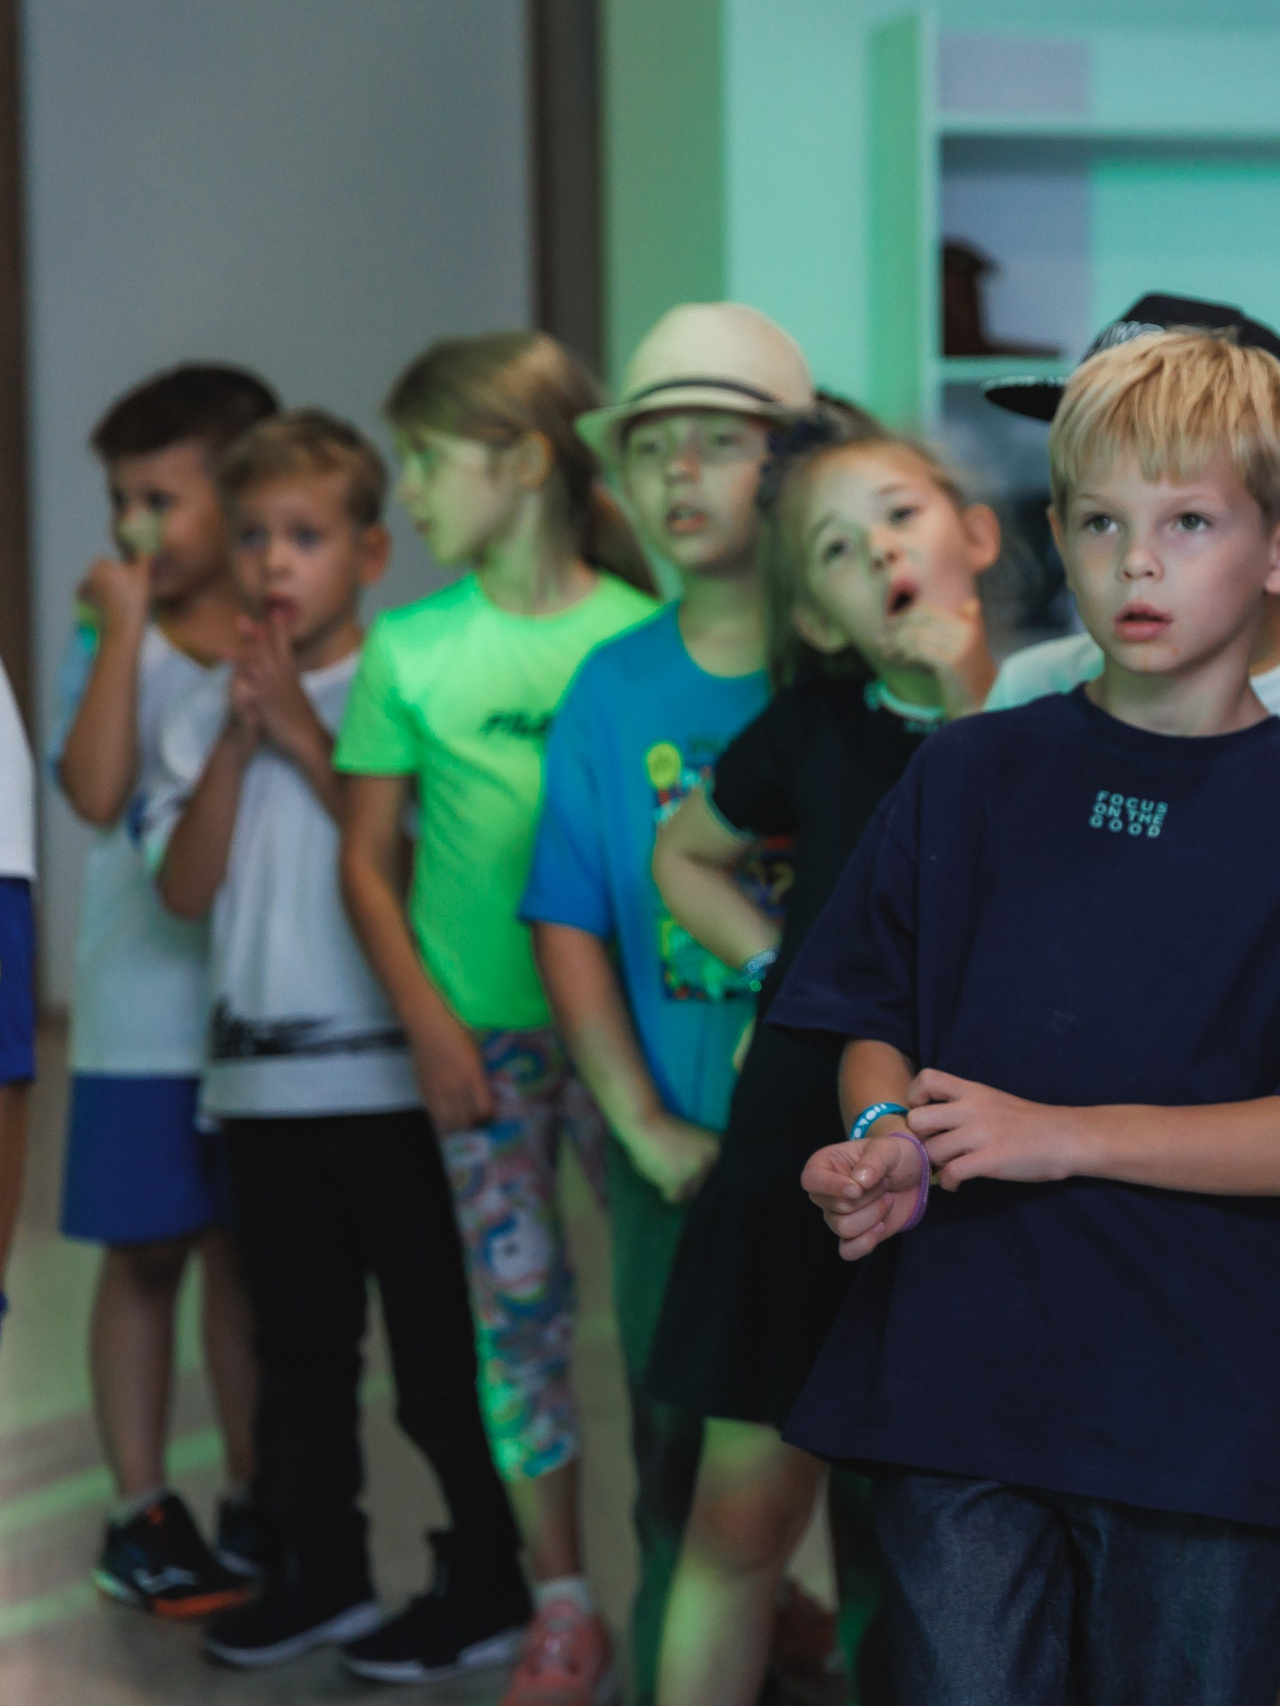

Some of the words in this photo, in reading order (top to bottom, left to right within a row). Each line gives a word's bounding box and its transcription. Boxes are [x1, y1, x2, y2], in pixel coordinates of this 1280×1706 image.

[1092, 802, 1121, 818] ON
[1128, 810, 1164, 826] THE
[1096, 790, 1168, 814] FOCUS
[1088, 814, 1161, 838] GOOD
